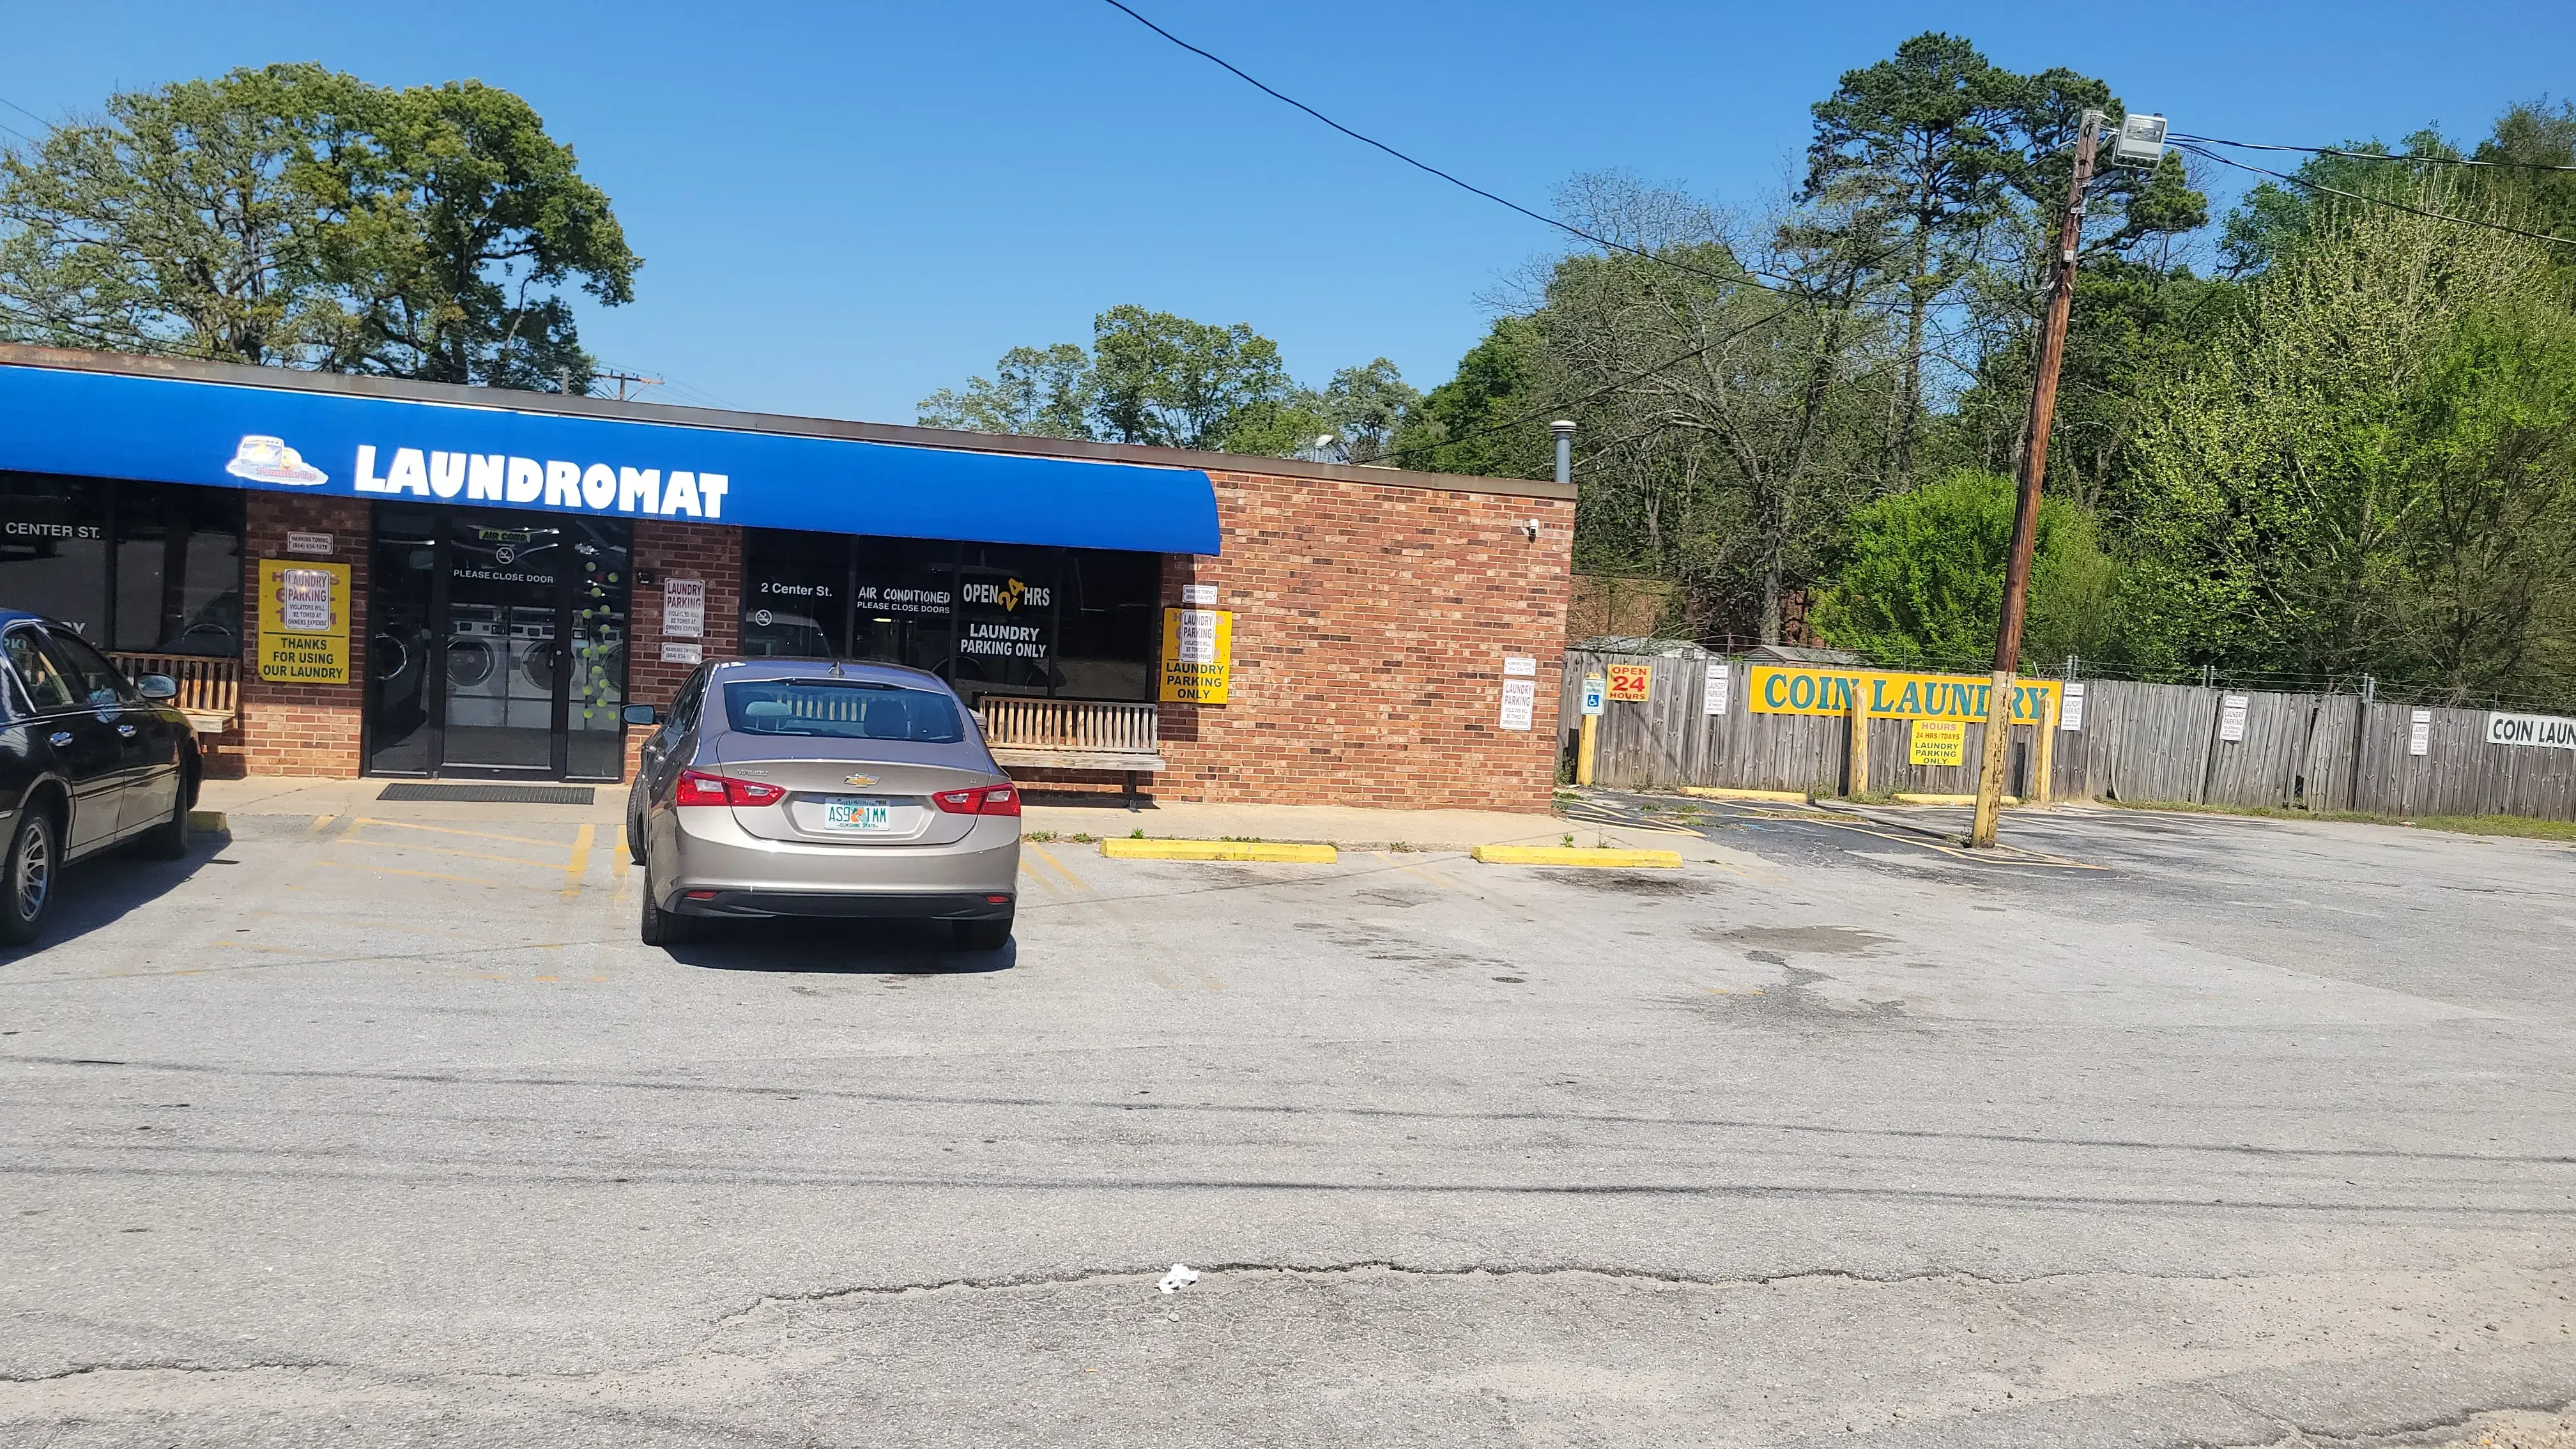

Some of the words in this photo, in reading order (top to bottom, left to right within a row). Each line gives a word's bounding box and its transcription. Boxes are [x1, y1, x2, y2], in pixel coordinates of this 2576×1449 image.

[354, 445, 729, 518] LAUNDROMAT
[6, 522, 73, 537] CENTER
[78, 526, 100, 539] ST.
[288, 574, 327, 588] LAUNDRY
[454, 570, 490, 579] PLEASE
[493, 572, 524, 581] CLOSE
[526, 575, 554, 583] DOOR
[288, 589, 326, 602] PARKING
[668, 583, 702, 596] LAUNDRY
[761, 583, 768, 592] 2
[772, 583, 813, 595] Center
[816, 586, 832, 597] St.
[858, 586, 877, 601] AIR
[884, 588, 950, 604] CONDITIONED
[963, 583, 998, 603] OPEN
[998, 578, 1025, 611] 24
[1024, 587, 1050, 606] HRS
[667, 597, 700, 609] PARKING
[857, 601, 889, 610] PLEASE
[1184, 615, 1213, 626] LAUNDRY
[970, 624, 1039, 641] LAUNDRY
[1183, 627, 1212, 639] PARKING
[281, 638, 326, 650] THANKS
[961, 640, 1012, 656] PARKING
[1015, 643, 1046, 658] ONLY
[273, 652, 295, 663] FOR
[299, 653, 334, 664] USING
[263, 665, 286, 676] OUR
[291, 666, 342, 678] LAUNDRY
[1166, 663, 1224, 674] LAUNDRY
[1612, 667, 1646, 675] OPEN
[1167, 676, 1222, 687] PARKING
[1612, 676, 1645, 692] 24
[1177, 689, 1210, 699] ONLY
[1506, 684, 1532, 695] LAUNDRY
[1765, 674, 1859, 710] COIN
[1505, 695, 1530, 707] PARKING
[1922, 722, 1956, 731] HOURS
[2493, 719, 2534, 742] COIN
[829, 807, 850, 822] AS9
